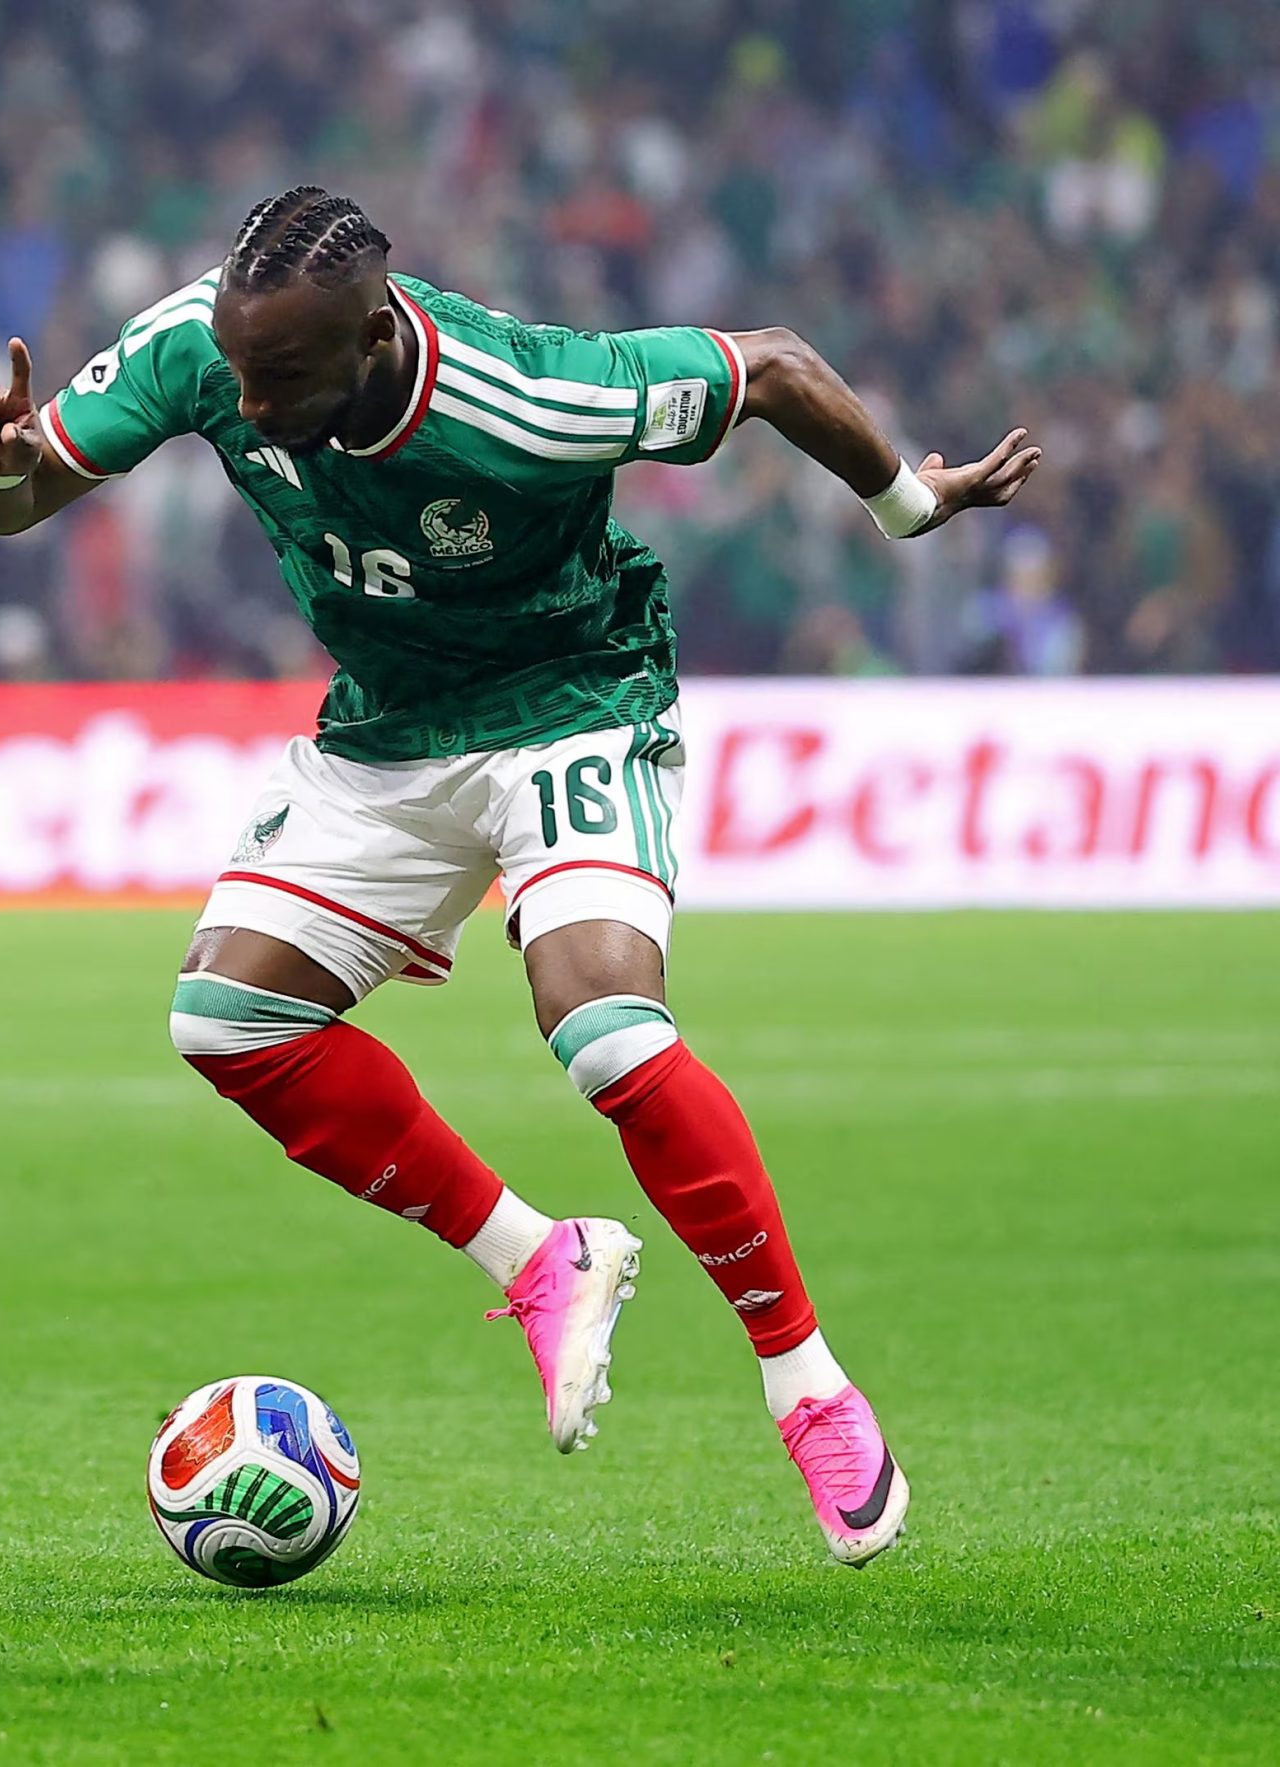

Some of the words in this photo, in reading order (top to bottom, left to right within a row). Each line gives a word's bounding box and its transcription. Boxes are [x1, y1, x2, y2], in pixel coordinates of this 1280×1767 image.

[677, 390, 692, 435] EDUCATION
[689, 404, 697, 421] FIFA
[324, 532, 417, 598] 16
[531, 755, 618, 848] 16
